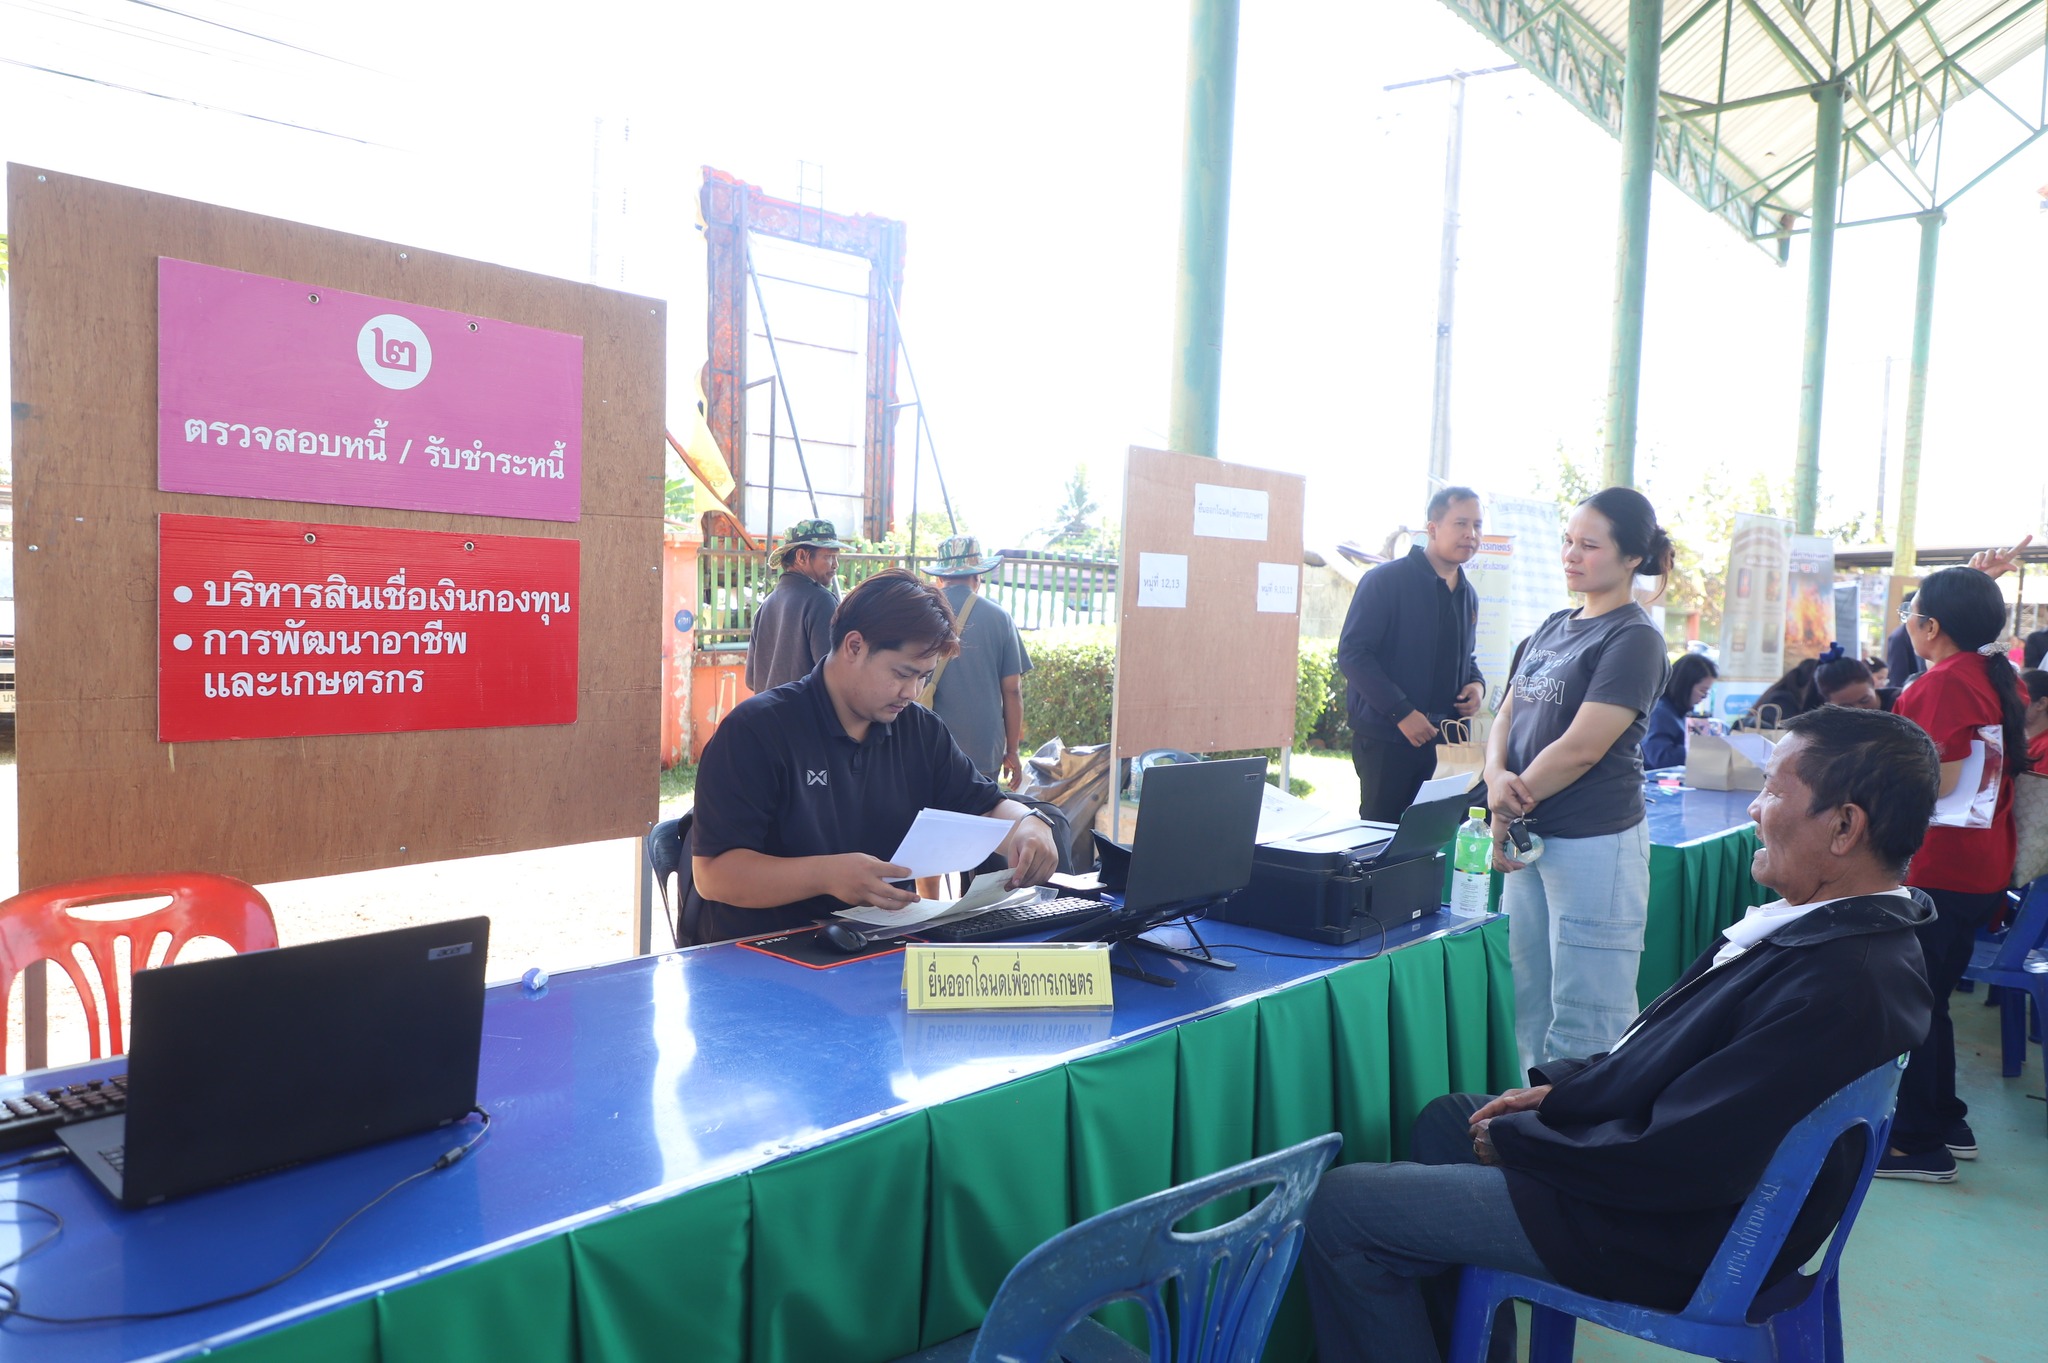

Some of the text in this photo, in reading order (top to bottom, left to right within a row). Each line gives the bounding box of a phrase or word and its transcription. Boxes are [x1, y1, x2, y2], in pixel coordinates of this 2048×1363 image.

[371, 326, 417, 373] ๒
[184, 418, 567, 481] ตรวจสอบหนี้ / รับชำระหนี้
[203, 567, 571, 626] บริหารสินเชื่อเงินกองทุน
[1161, 578, 1180, 590] 12,13
[203, 618, 468, 656] การพัฒนาอาชีพ
[203, 667, 425, 699] และเกษตรกร
[928, 952, 1094, 998] ยื่นออกโฉนดเพื่อการเกษตร
